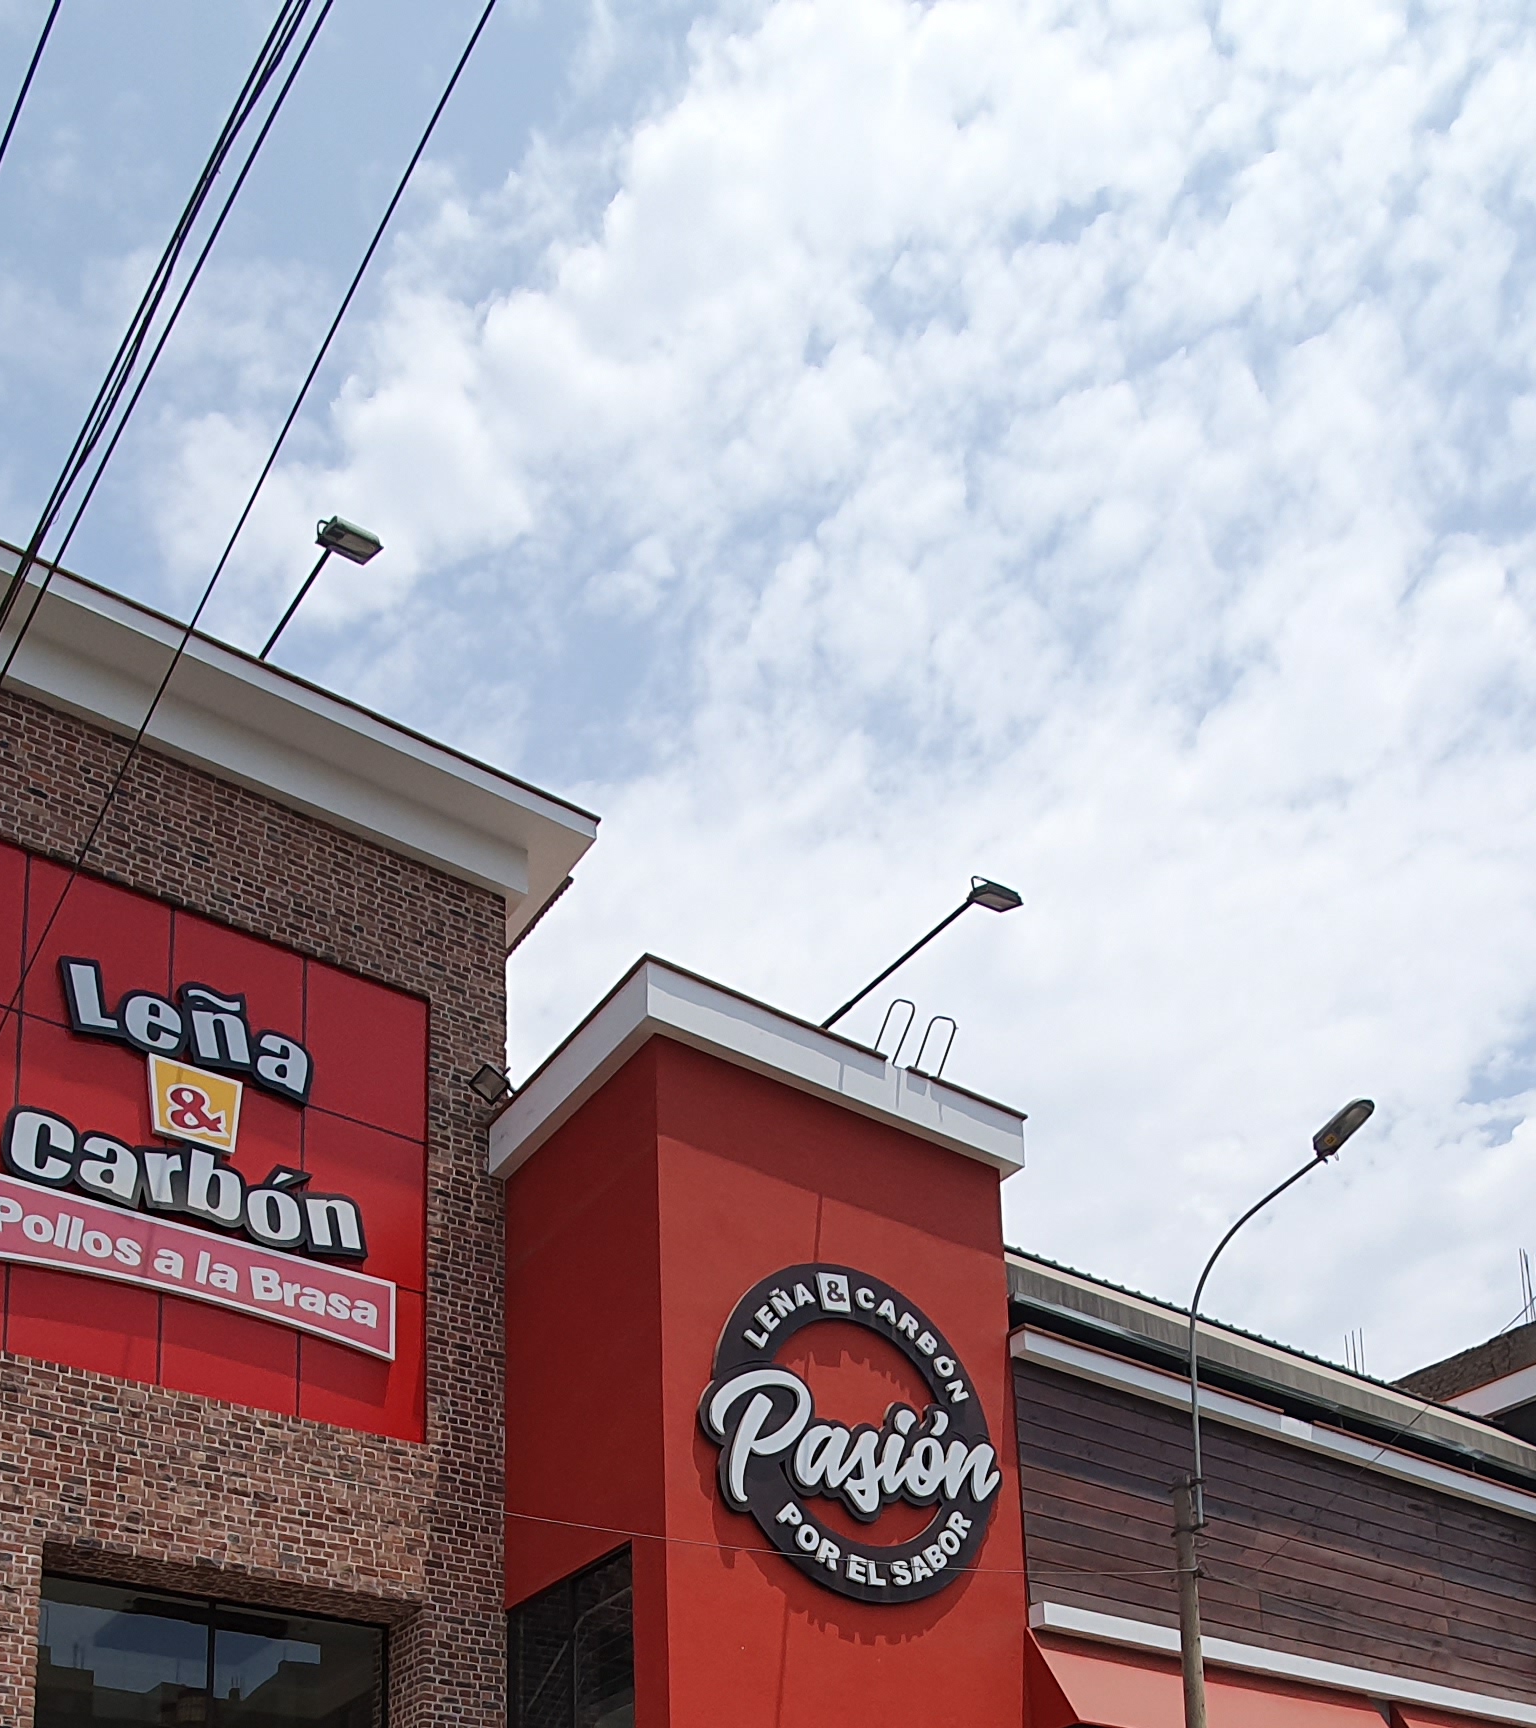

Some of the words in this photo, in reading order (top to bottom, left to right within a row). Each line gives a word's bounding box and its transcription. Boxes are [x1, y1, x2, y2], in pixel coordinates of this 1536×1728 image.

[62, 957, 312, 1099] Leña
[167, 1082, 231, 1138] &
[7, 1107, 363, 1254] Carbón
[153, 1239, 186, 1279] a
[194, 1249, 239, 1294] la
[250, 1263, 379, 1330] Brasa
[743, 1282, 816, 1350] LEÑA
[854, 1287, 969, 1404] CARBÓN
[709, 1368, 1002, 1514] Pasión
[775, 1501, 842, 1571] POR
[846, 1553, 887, 1587] EL
[890, 1510, 973, 1587] SABOR
